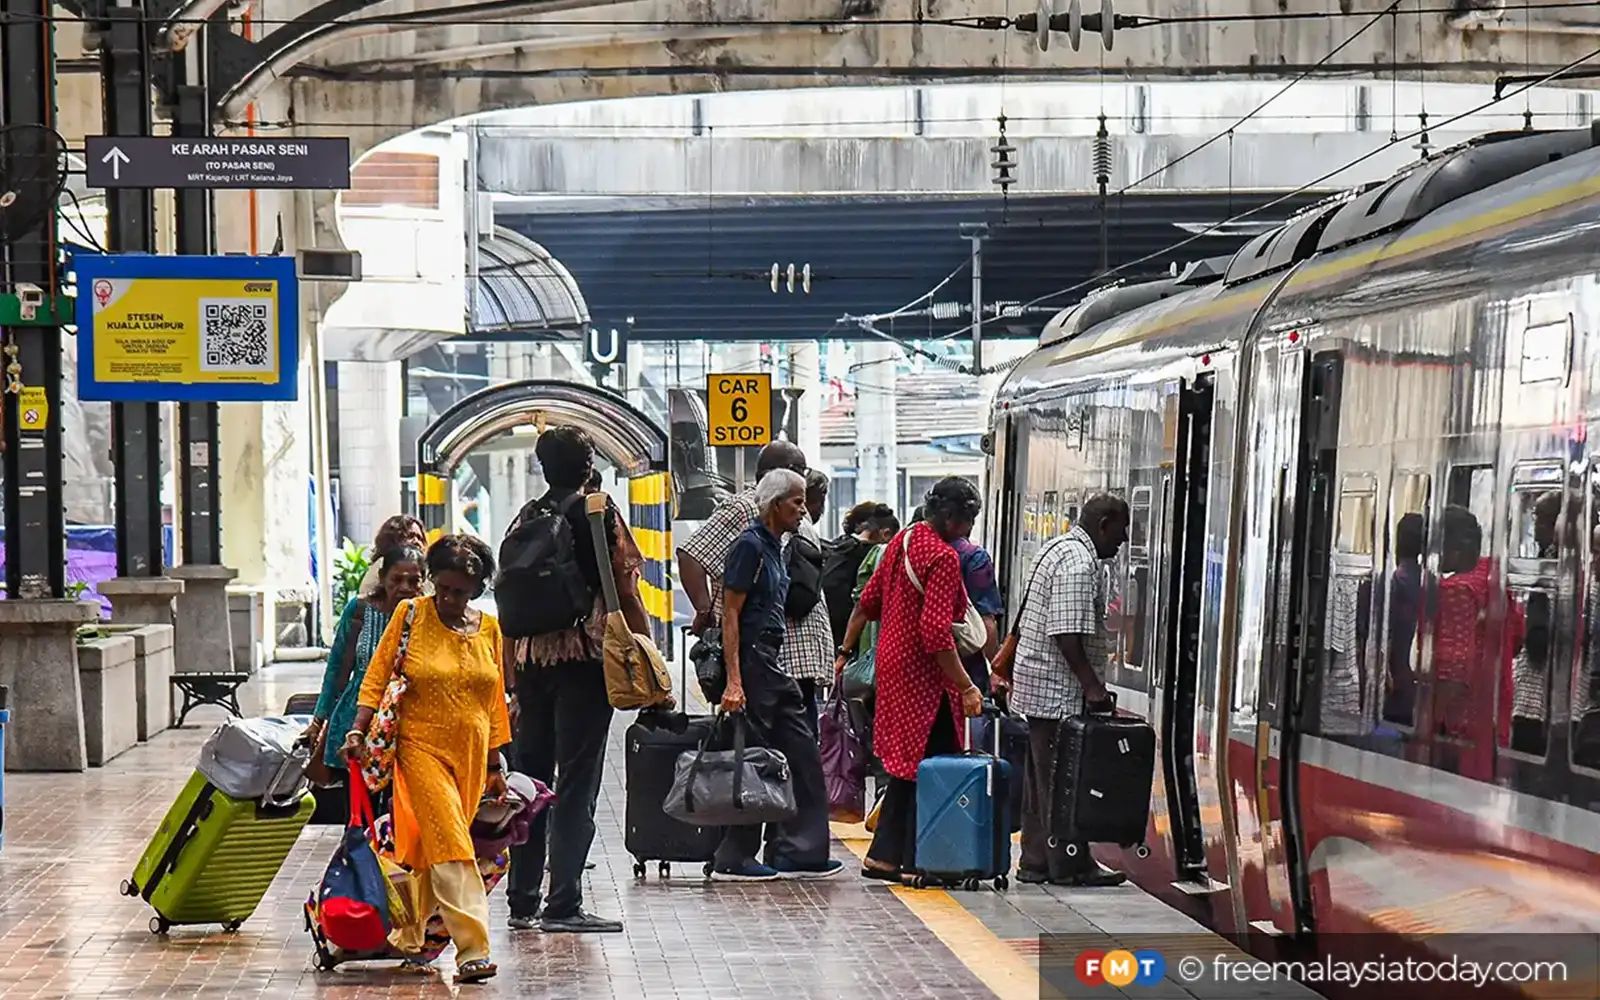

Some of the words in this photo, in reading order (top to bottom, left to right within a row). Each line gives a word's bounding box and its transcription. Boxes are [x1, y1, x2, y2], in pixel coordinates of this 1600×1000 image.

[171, 144, 189, 155] KE
[192, 144, 229, 155] ARAH
[232, 144, 276, 155] PASAR
[278, 144, 309, 156] SENI
[205, 161, 220, 171] (TO
[222, 162, 251, 171] PASAR
[252, 162, 276, 171] SENI)
[205, 174, 230, 182] Kajang
[277, 174, 293, 182] Jaya
[127, 313, 164, 321] STESEN
[107, 322, 141, 330] KUALA
[143, 322, 185, 330] LUMPUR
[591, 328, 618, 363] U
[718, 379, 759, 395] CAR
[731, 397, 748, 423] 6
[714, 426, 765, 442] STOP
